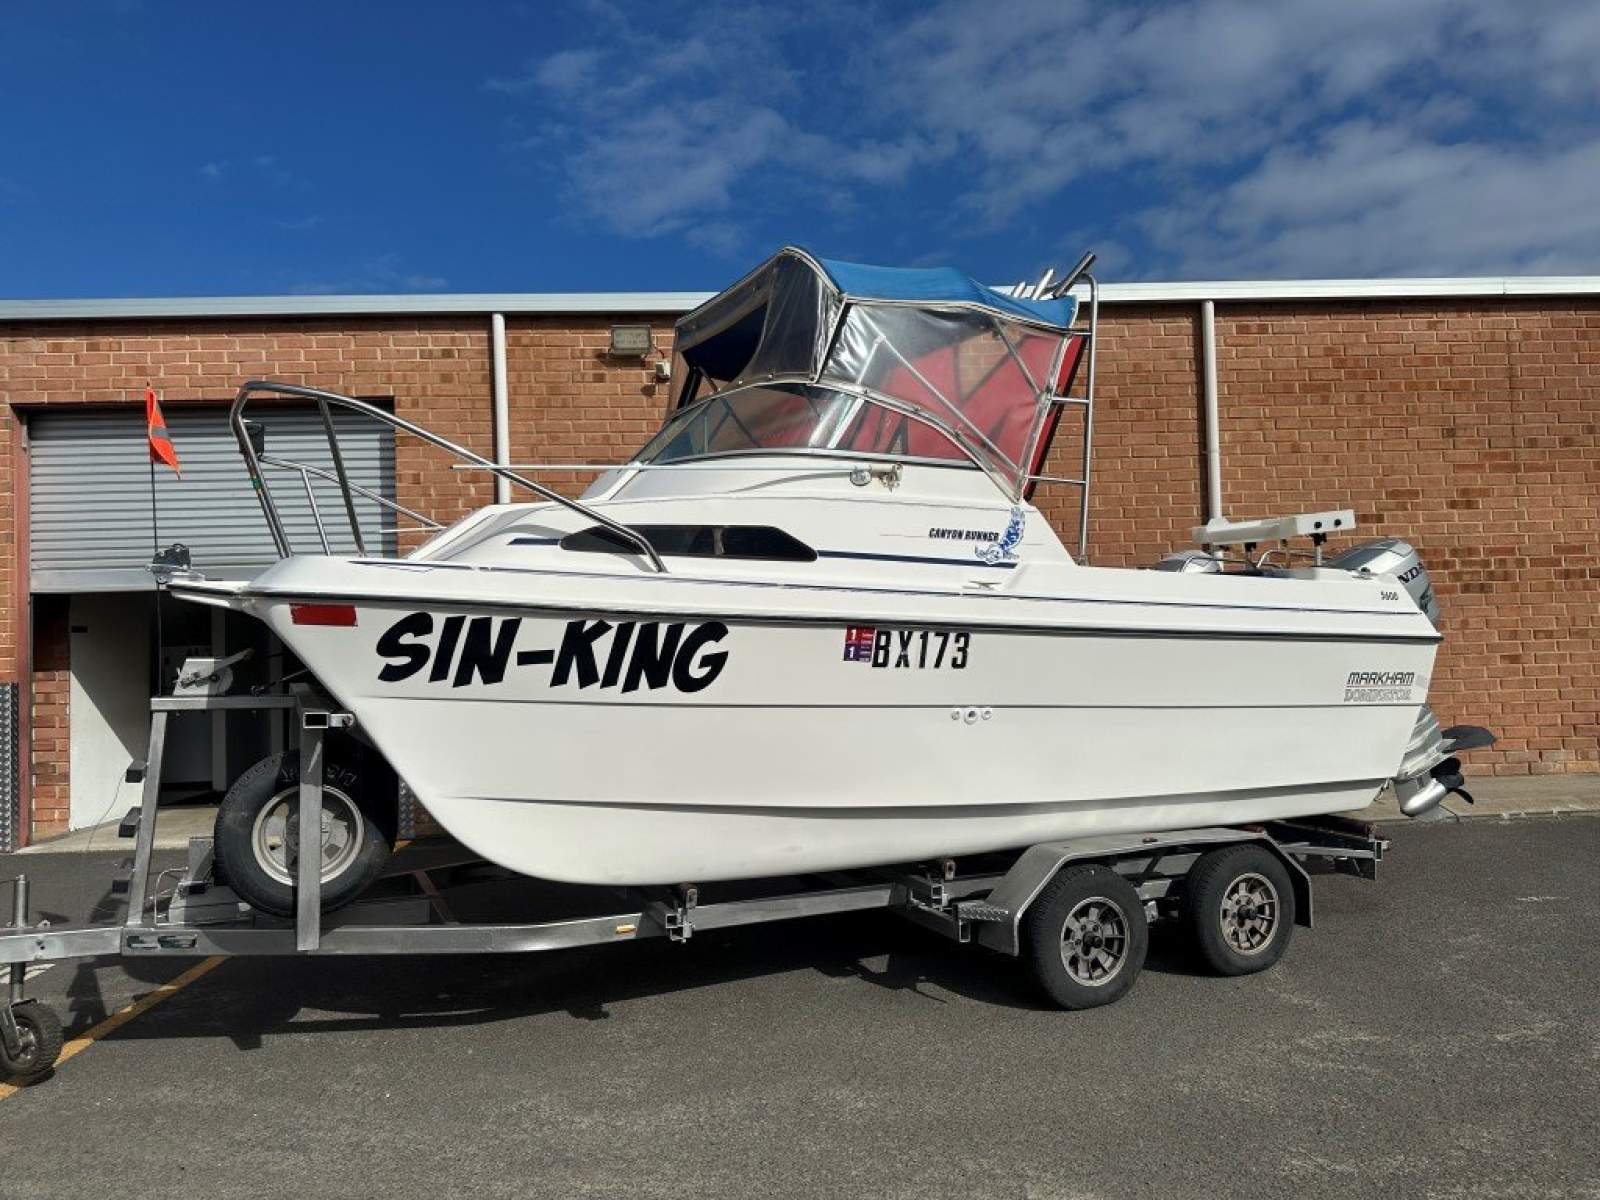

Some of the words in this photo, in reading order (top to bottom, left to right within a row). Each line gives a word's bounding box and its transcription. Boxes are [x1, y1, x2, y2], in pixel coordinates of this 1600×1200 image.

[929, 528, 964, 540] CANYON
[965, 530, 1000, 541] RUNNER
[375, 611, 729, 694] SIN-KING
[872, 630, 970, 669] BX173
[1347, 671, 1415, 685] MARKHAM
